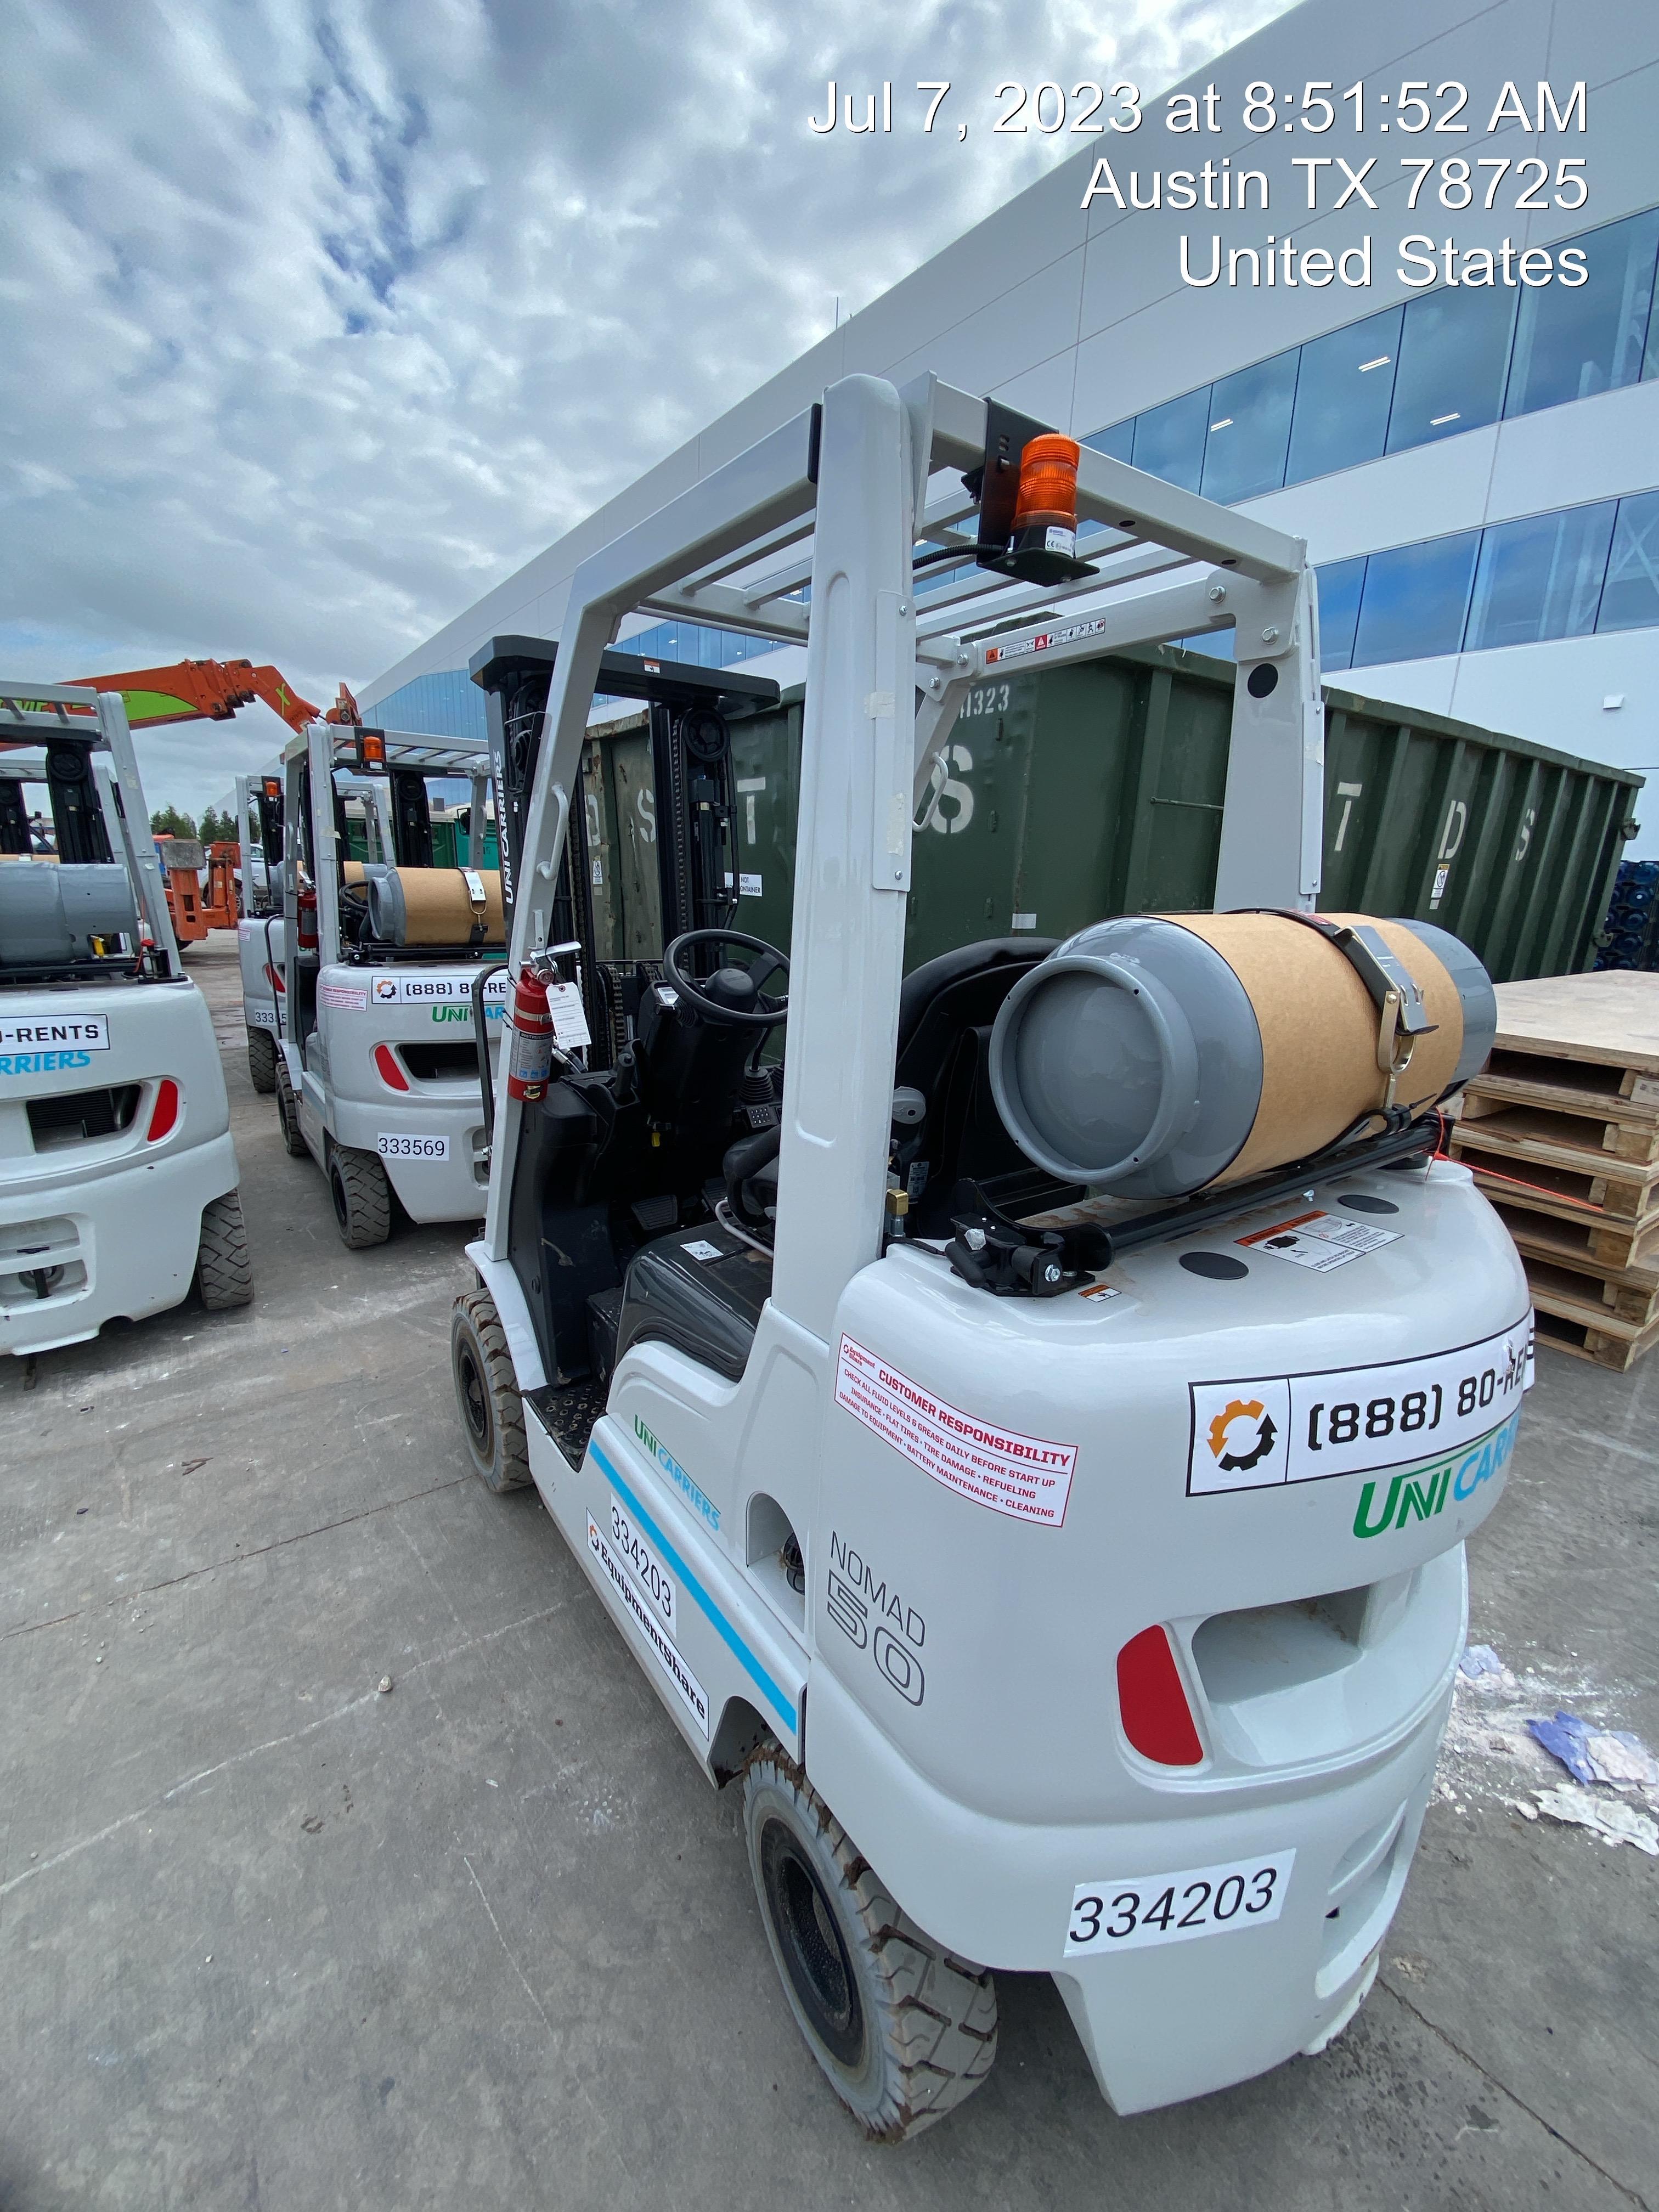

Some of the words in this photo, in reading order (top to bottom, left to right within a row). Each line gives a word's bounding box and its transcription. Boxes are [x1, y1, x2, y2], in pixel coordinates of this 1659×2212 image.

[1437, 800, 1467, 860] D
[740, 885, 761, 894] ONTAINER
[405, 983, 453, 996] (888)
[378, 1137, 445, 1156] 333569
[849, 1352, 863, 1366] Share
[850, 1346, 876, 1369] Equipment
[839, 1391, 861, 1413] DAMAGE
[861, 1408, 868, 1419] TO
[869, 1414, 904, 1446] EQUIPMENT
[906, 1444, 935, 1470] BATTERY
[936, 1465, 998, 1503] MAINTENANCE
[1005, 1498, 1054, 1518] CLEANING
[844, 1368, 861, 1386] CHECK
[861, 1383, 871, 1394] ALL
[872, 1389, 889, 1406] FLUID
[889, 1402, 911, 1423] LEVELS
[912, 1418, 917, 1427] &
[918, 1423, 944, 1446] GREASE
[946, 1441, 970, 1459] DAILY
[971, 1454, 1007, 1475] BEFORE
[1008, 1470, 1040, 1487] START
[1042, 1477, 1056, 1488] UP
[851, 1387, 882, 1416] INSURANCE
[885, 1413, 899, 1429] FLAT
[900, 1424, 919, 1443] TIRES
[923, 1441, 940, 1458] TIRE
[941, 1453, 977, 1479] DAMAGE
[983, 1476, 1036, 1499] REFUELING
[878, 1369, 936, 1418] CUSTOMER
[938, 1409, 1071, 1467] RESPONSIBILITY
[1307, 1384, 1442, 1451] (888)
[612, 1506, 671, 1618] 334203
[829, 1530, 926, 1647] NOMAD
[601, 1541, 706, 1719] EquipmentShare
[827, 1568, 925, 1706] 50
[1069, 1867, 1277, 1943] 334203
